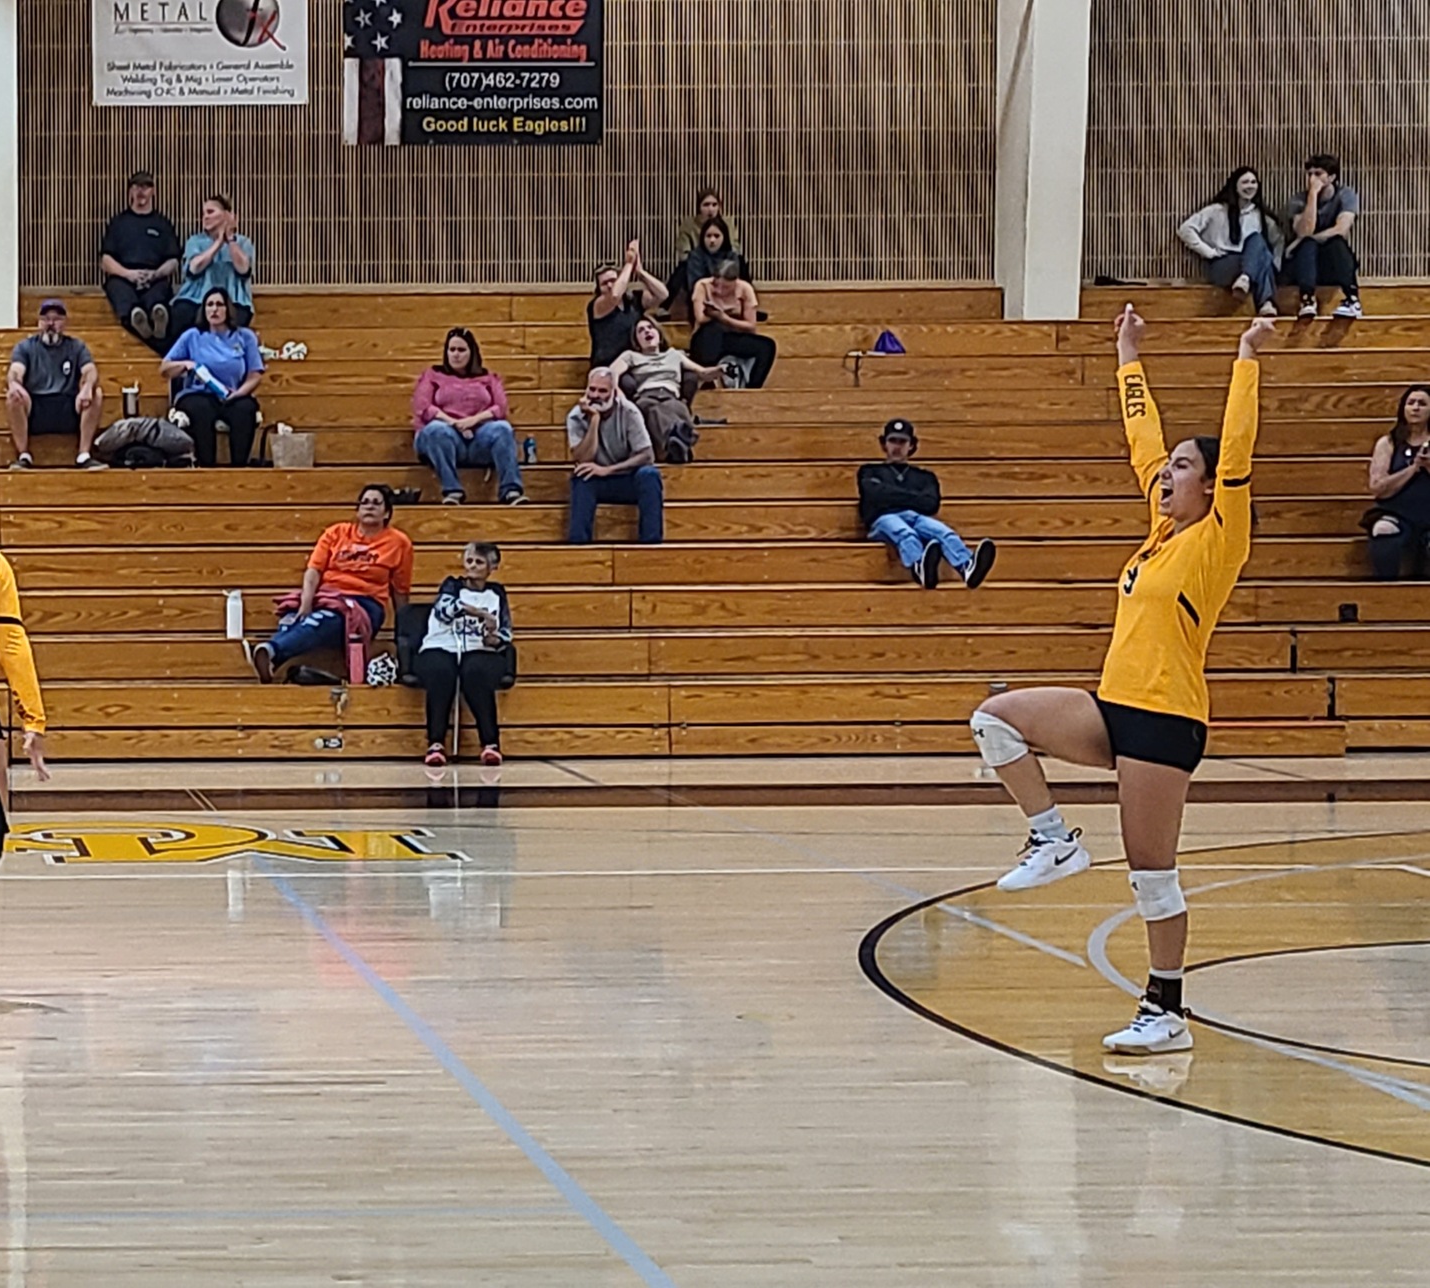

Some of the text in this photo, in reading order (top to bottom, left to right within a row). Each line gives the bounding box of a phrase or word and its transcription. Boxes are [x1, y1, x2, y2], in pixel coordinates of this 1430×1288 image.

[113, 2, 208, 22] METAL
[424, 0, 587, 30] Reliance
[450, 22, 572, 33] Enterprises
[420, 38, 587, 63] Heating & Air Conditioning
[445, 72, 560, 91] (707)462-7279
[406, 94, 598, 112] reliance-enterprises.com
[422, 115, 587, 135] Good luck Eagles!!!
